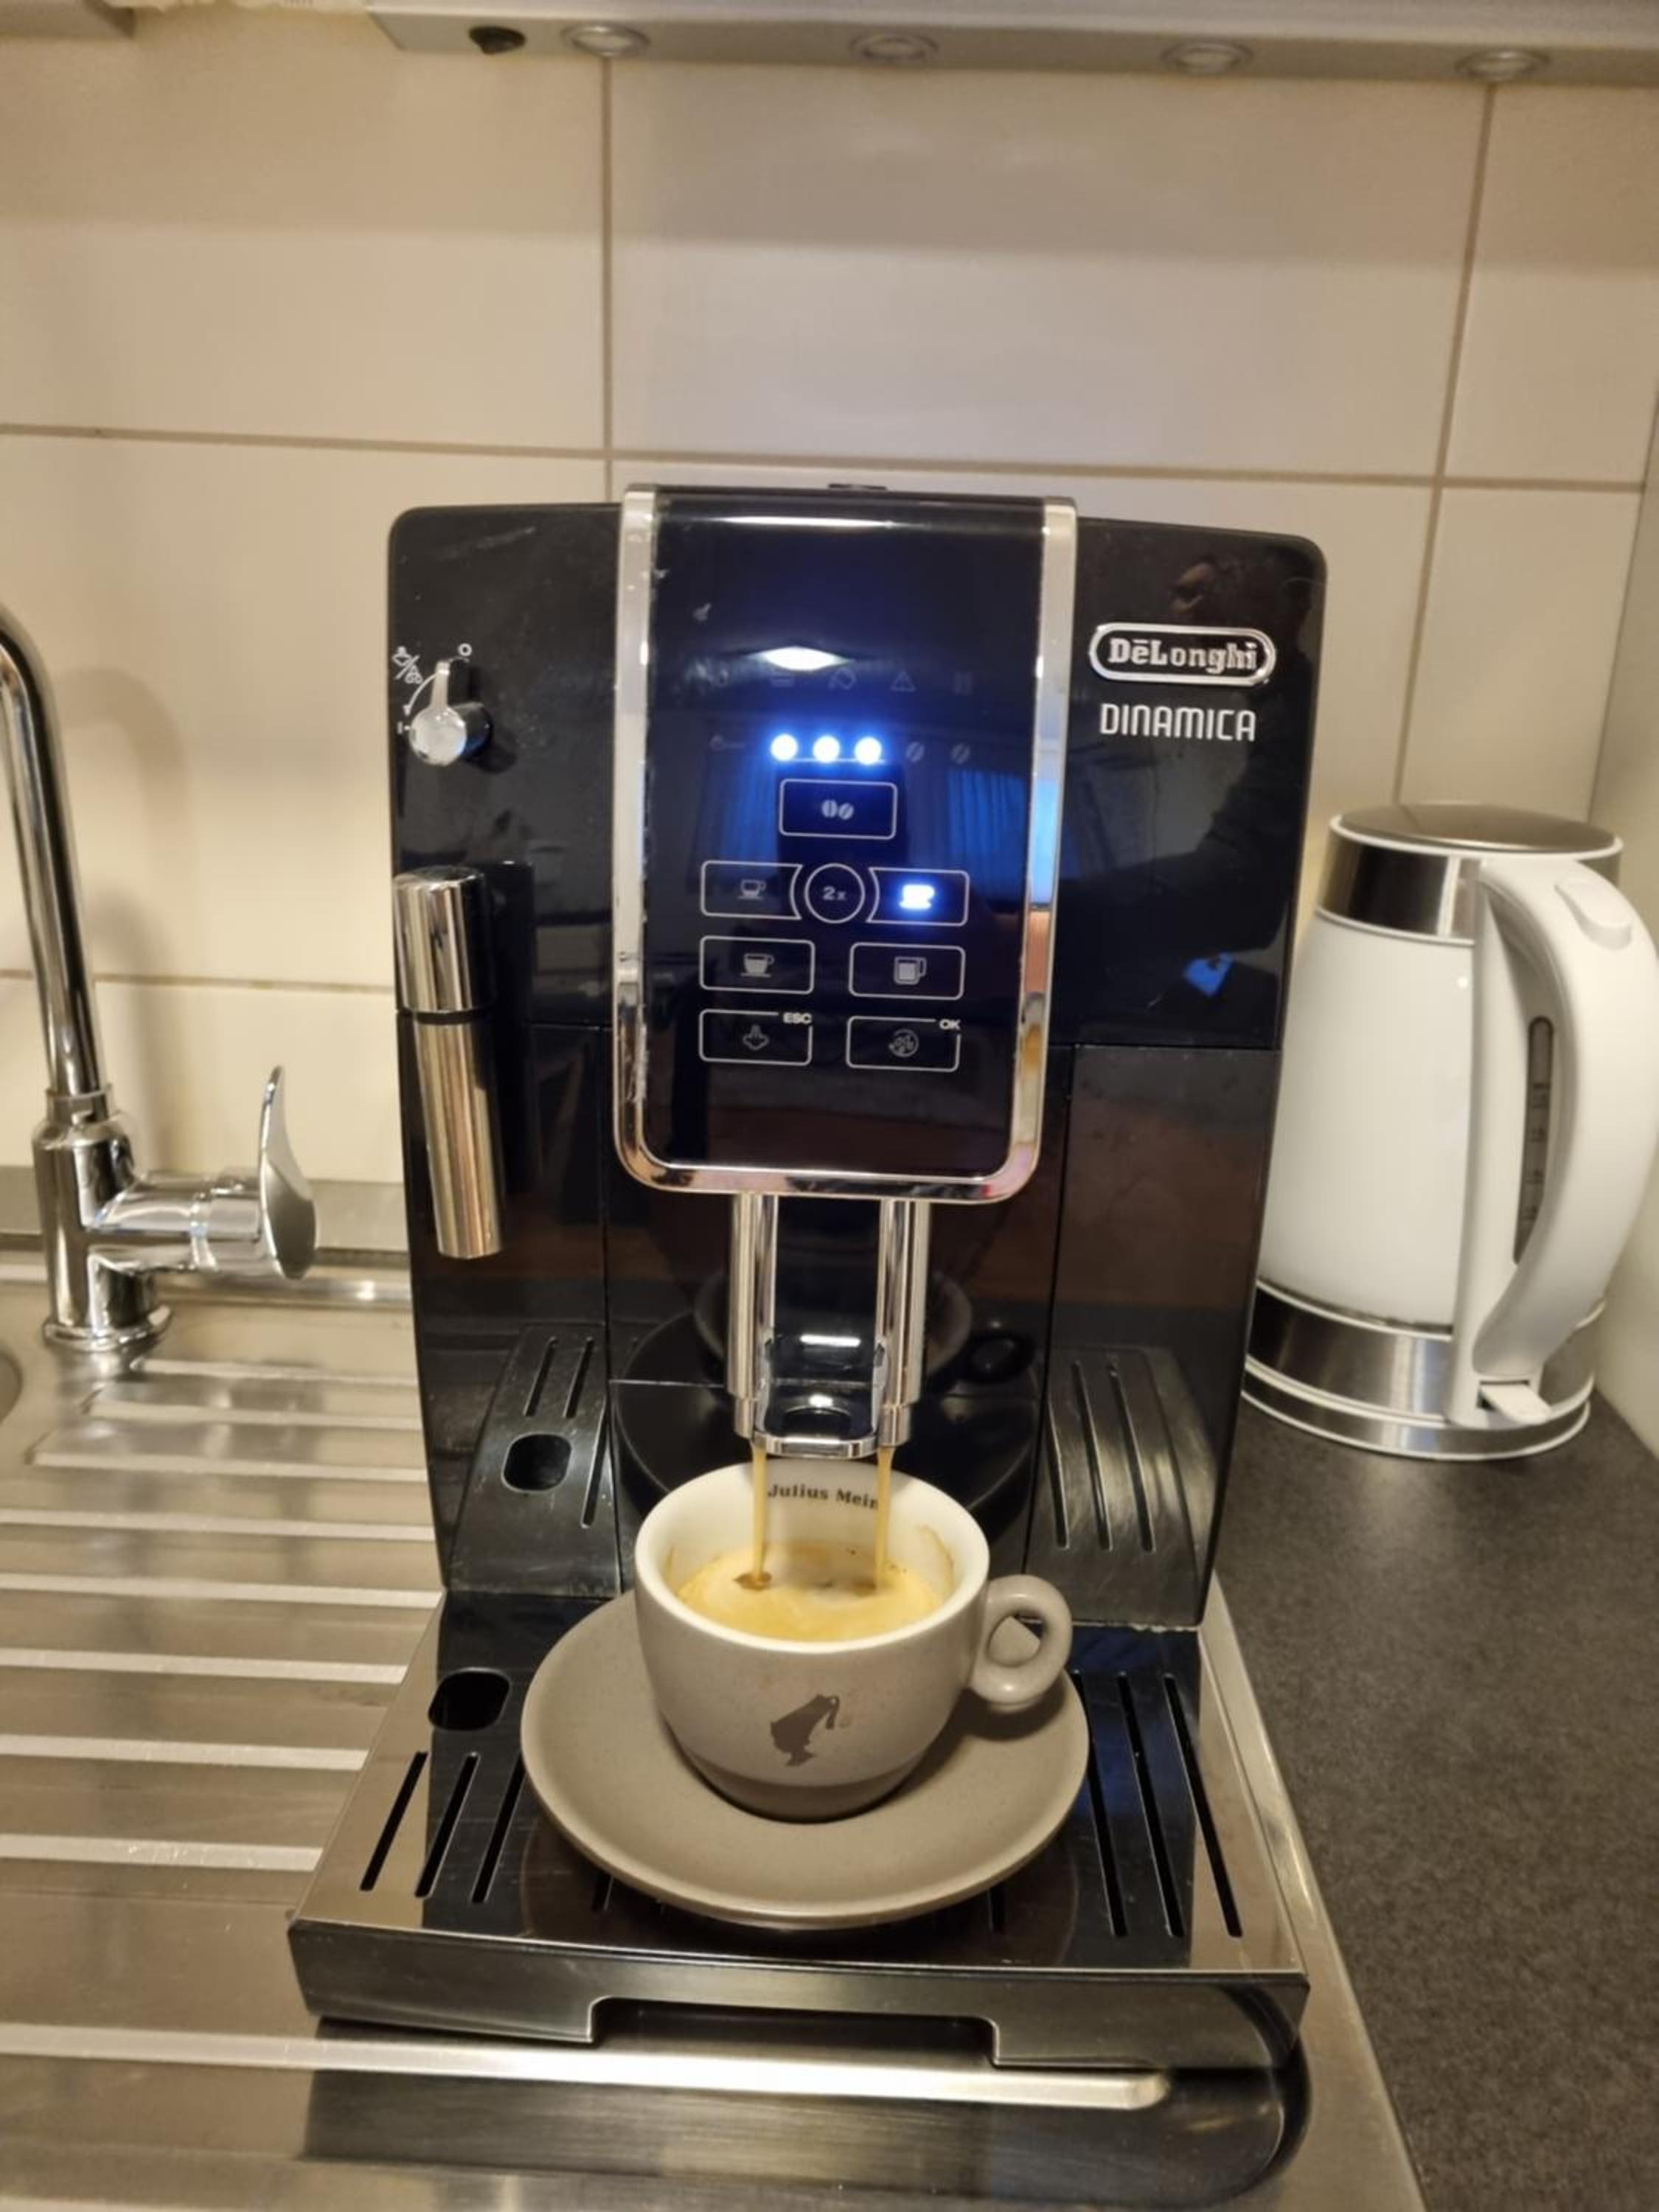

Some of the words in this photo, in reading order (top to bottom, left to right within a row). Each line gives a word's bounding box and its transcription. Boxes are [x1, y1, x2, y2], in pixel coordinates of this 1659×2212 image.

[1100, 703, 1256, 742] DINAMICA
[823, 886, 846, 900] 2x
[783, 1012, 811, 1024] ESC
[939, 1018, 961, 1030] OK
[768, 1484, 829, 1500] Julius
[836, 1488, 879, 1509] Mein
